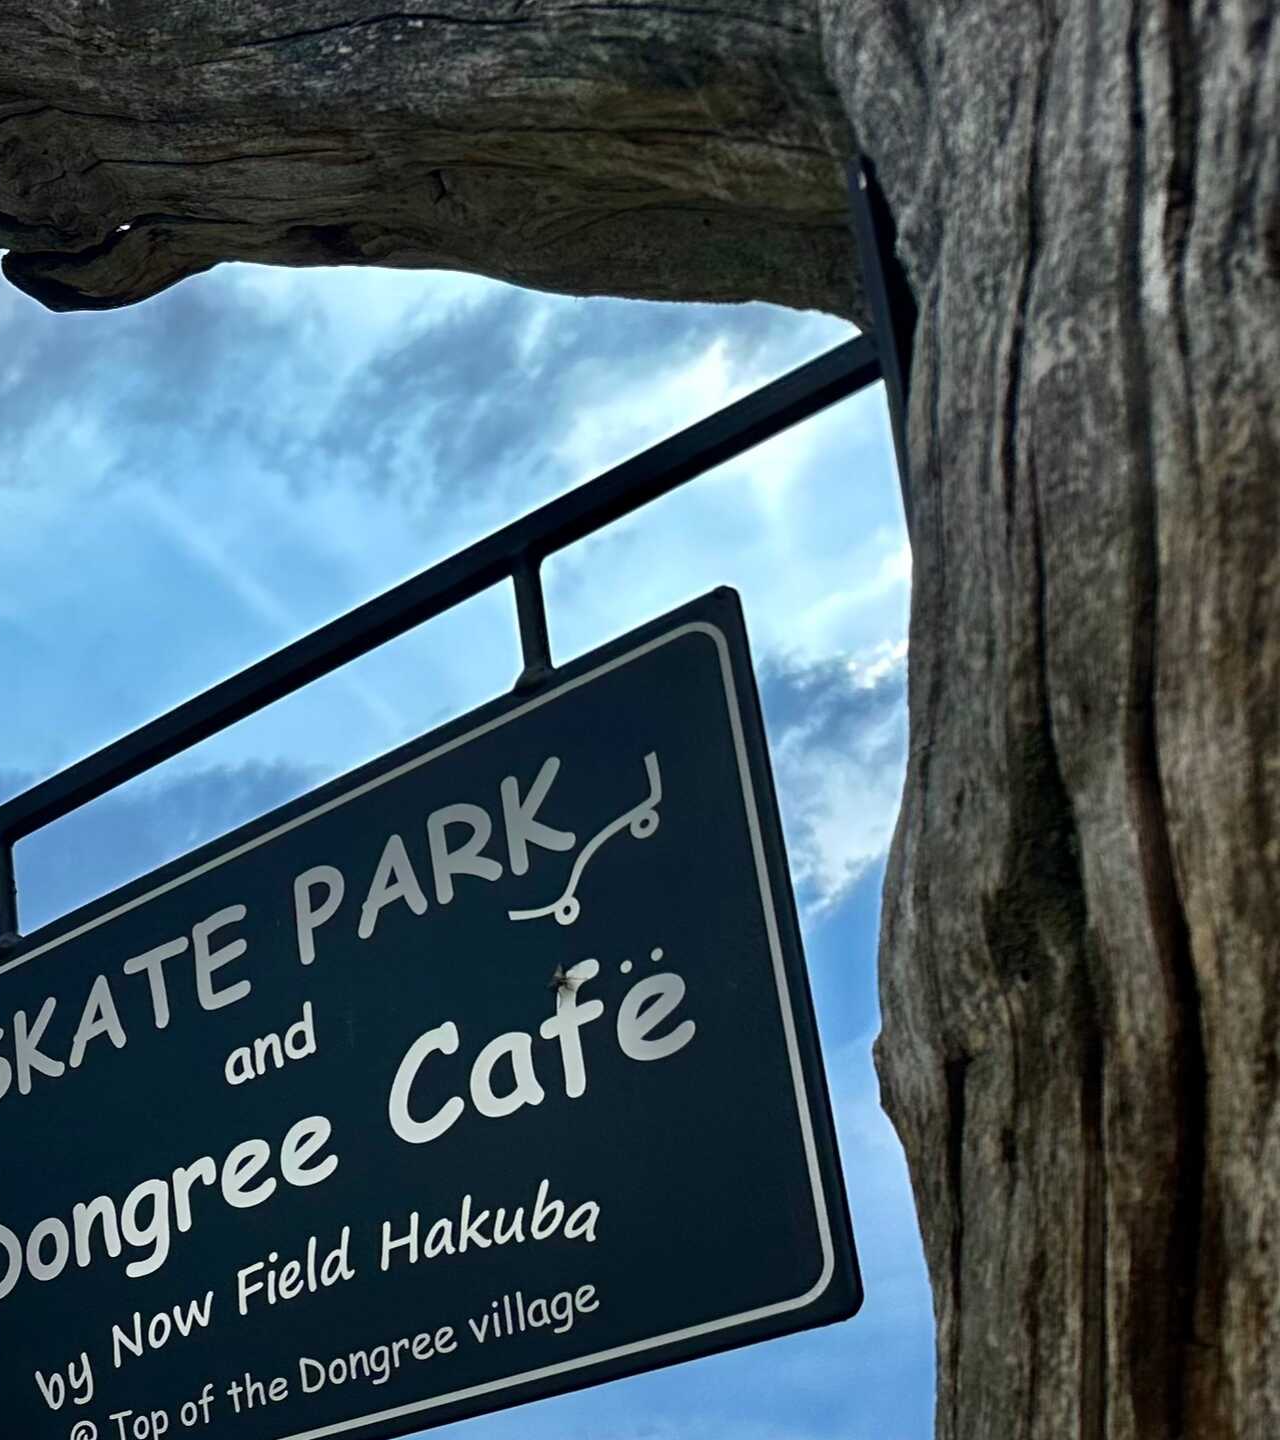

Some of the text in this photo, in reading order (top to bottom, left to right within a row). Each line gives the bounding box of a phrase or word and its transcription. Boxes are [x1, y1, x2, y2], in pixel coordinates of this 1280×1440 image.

[293, 755, 578, 967] PARK
[222, 999, 318, 1087] and
[34, 1177, 602, 1412] by Now Field Hakuba
[179, 1382, 216, 1428] of
[225, 1370, 290, 1414] the
[297, 1324, 460, 1394] Dongree
[466, 1282, 602, 1345] village
